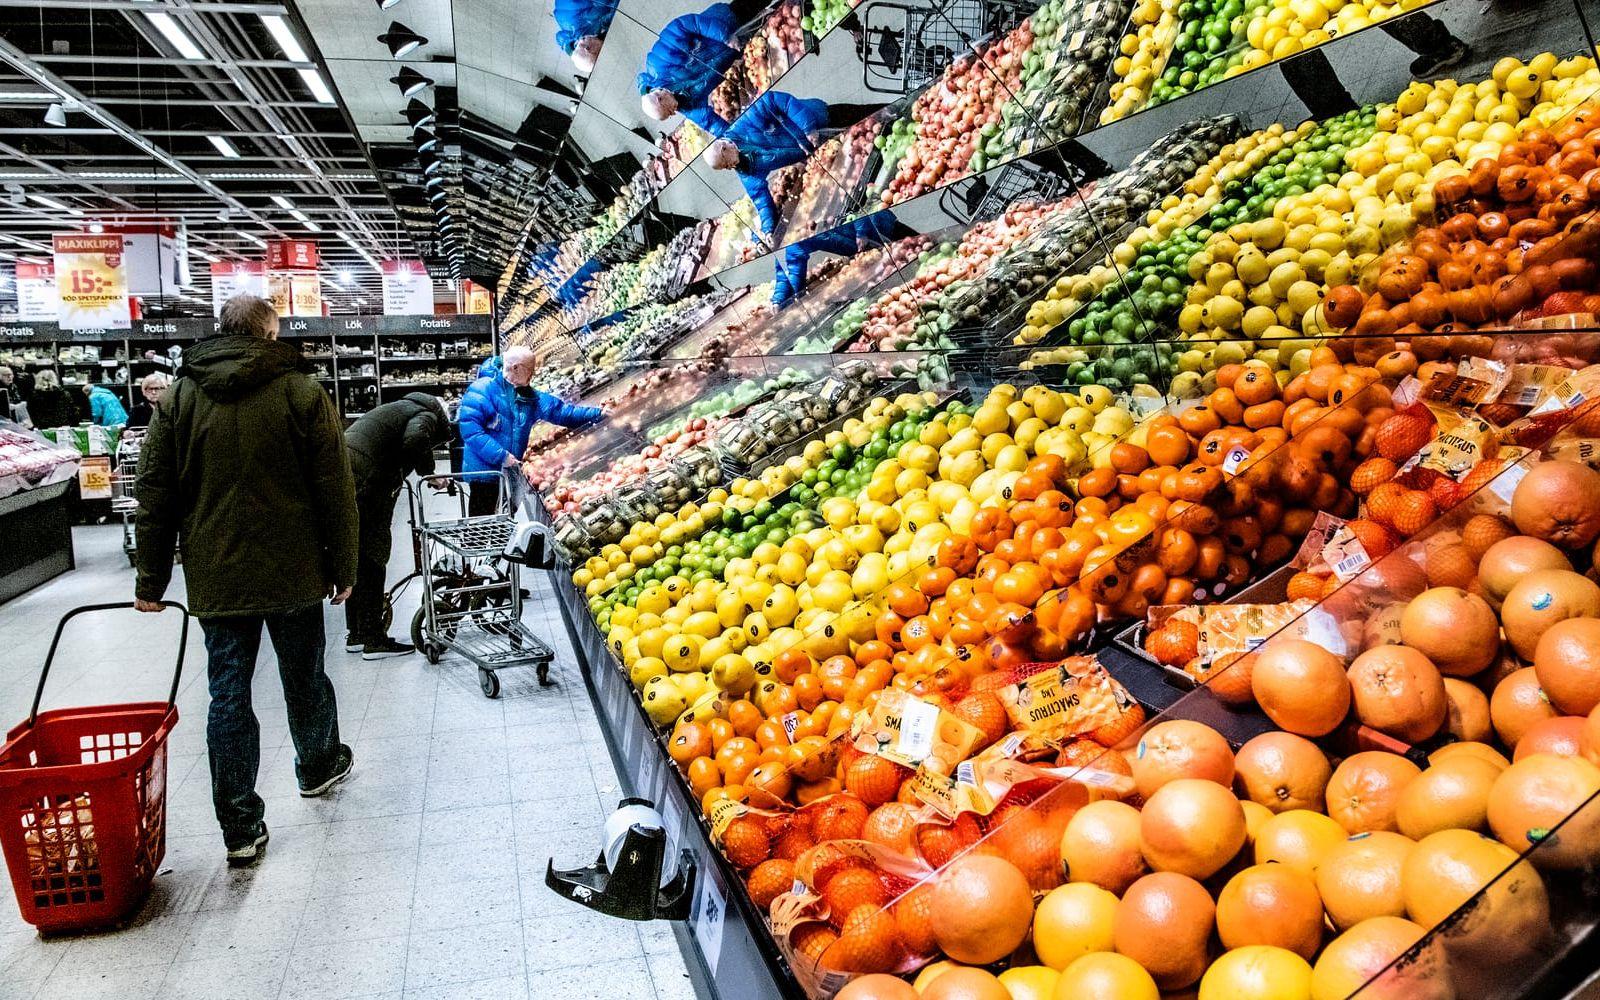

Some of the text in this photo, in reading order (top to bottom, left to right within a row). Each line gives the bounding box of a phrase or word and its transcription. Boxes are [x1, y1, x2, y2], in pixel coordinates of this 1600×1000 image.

[143, 324, 177, 333] Potatis
[289, 320, 308, 331] Lök
[345, 319, 363, 330] Lök
[420, 319, 451, 328] Potatis
[0, 326, 34, 336] Potatis
